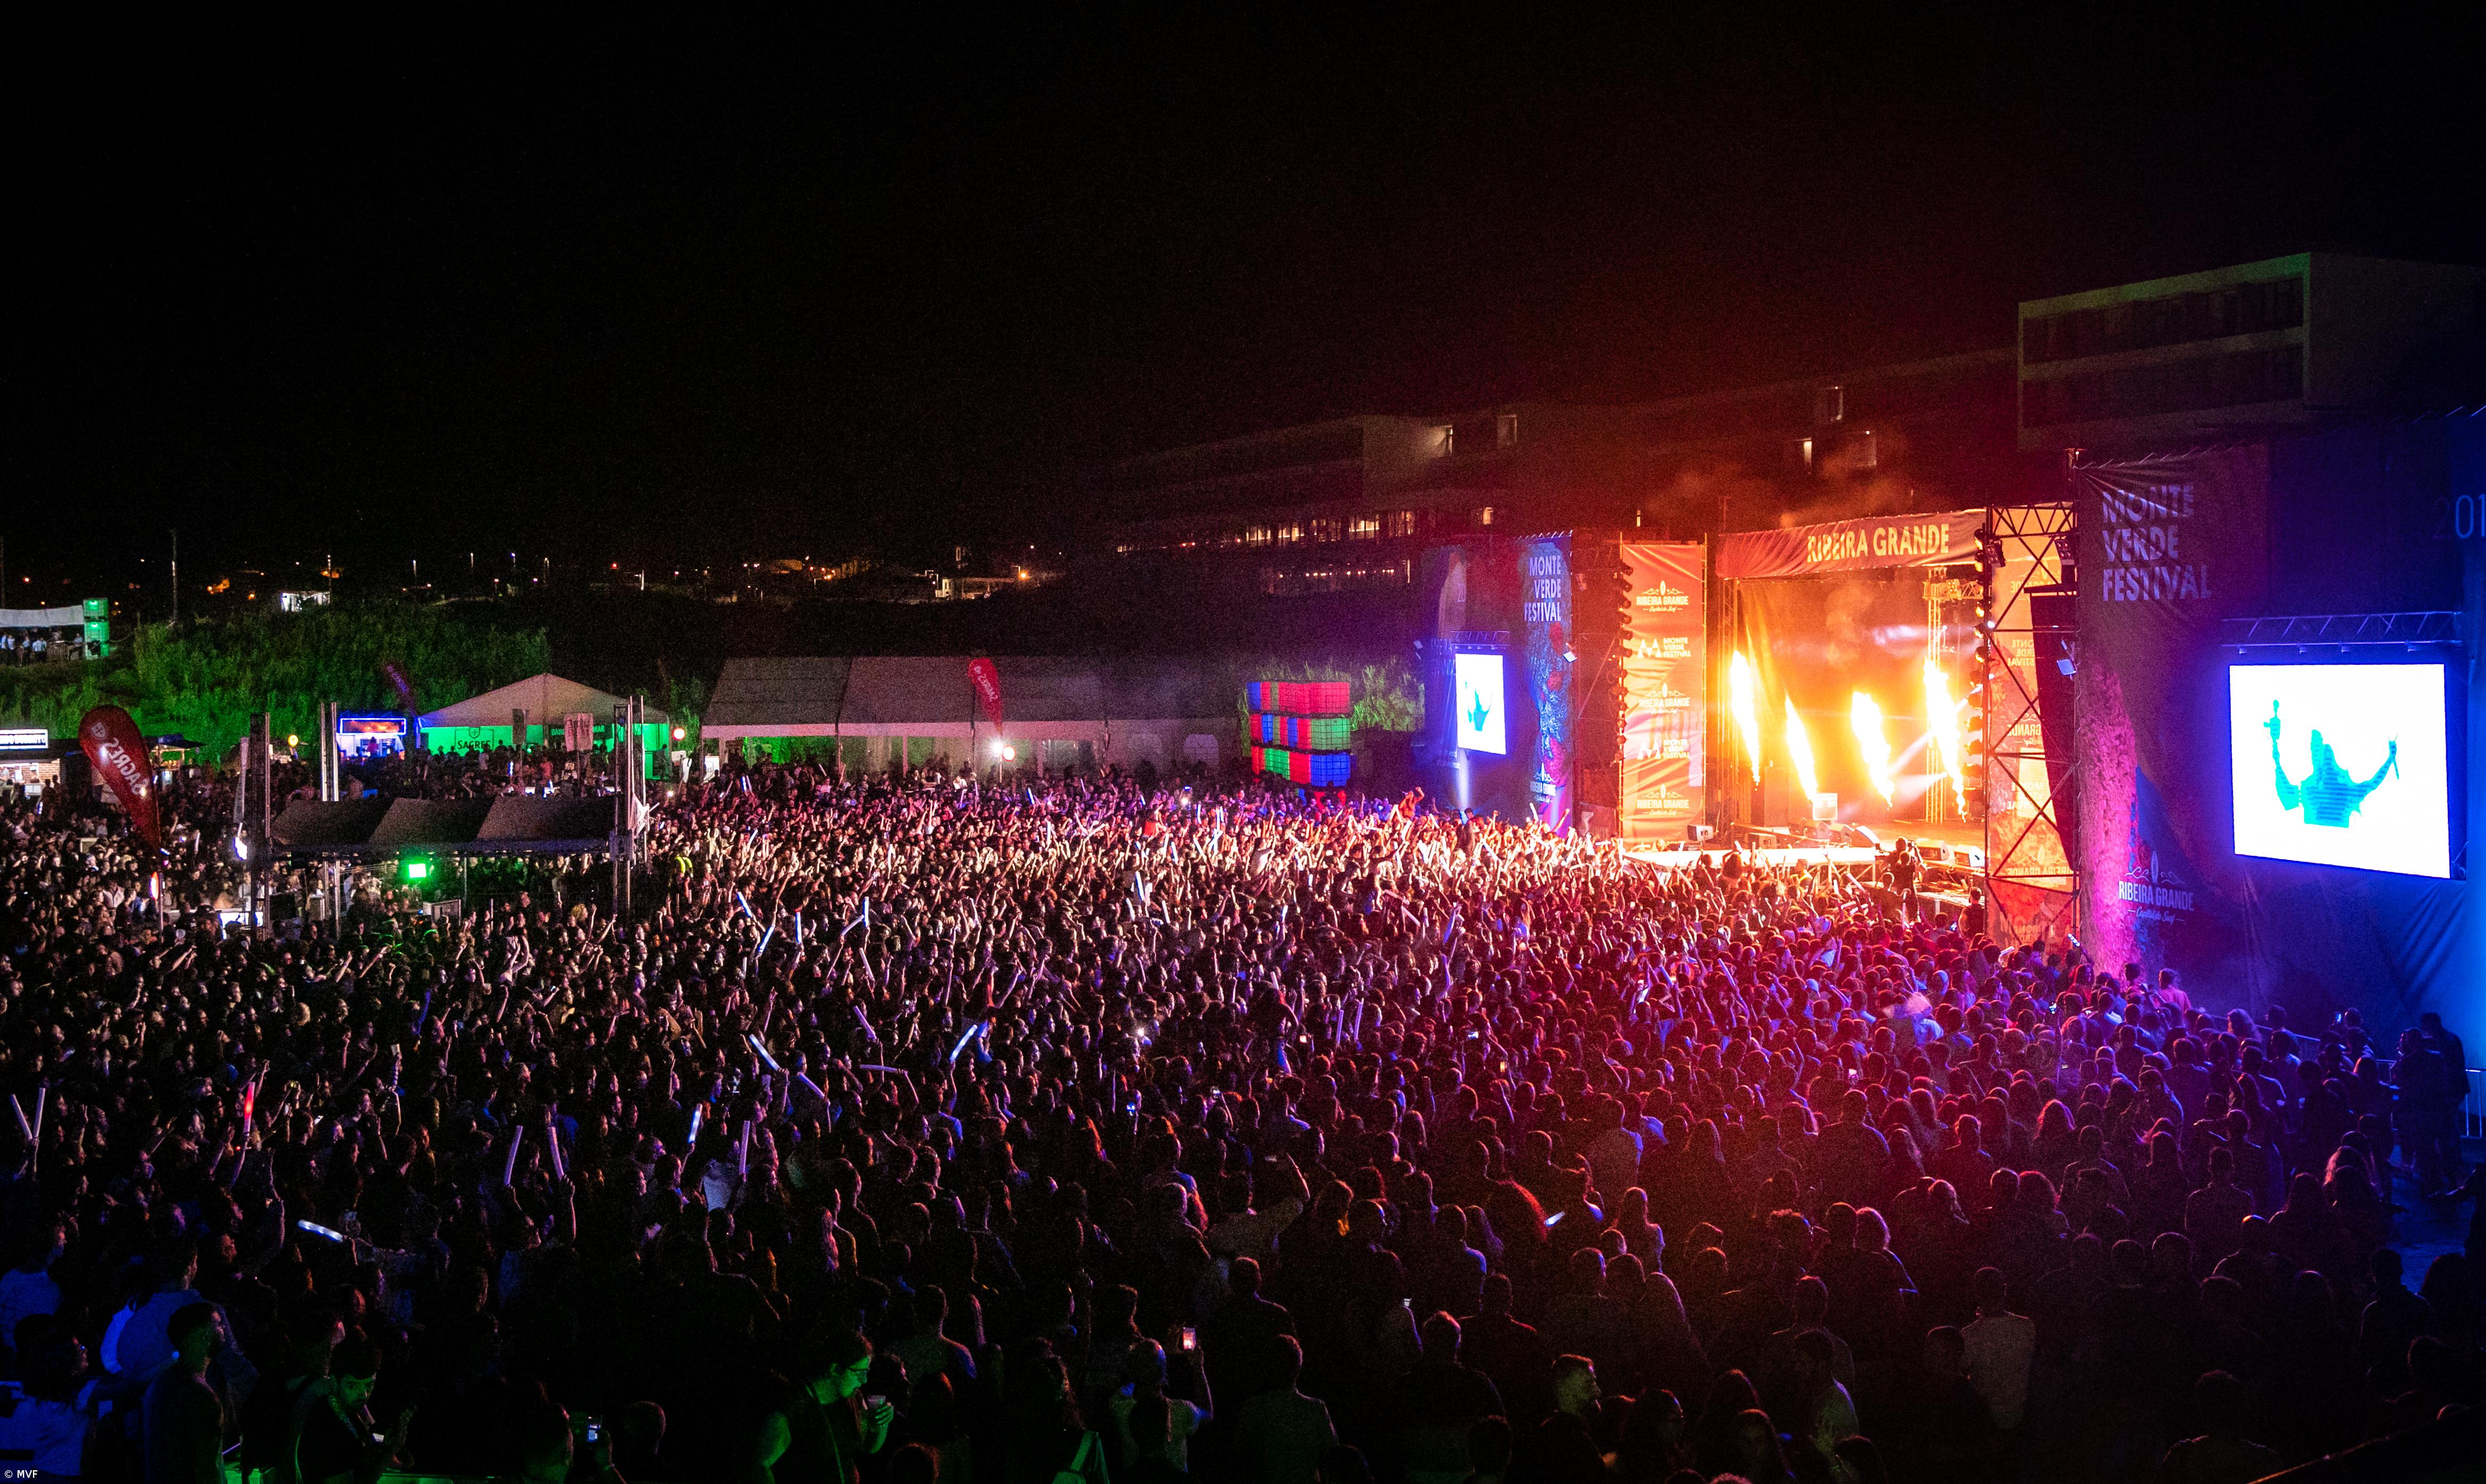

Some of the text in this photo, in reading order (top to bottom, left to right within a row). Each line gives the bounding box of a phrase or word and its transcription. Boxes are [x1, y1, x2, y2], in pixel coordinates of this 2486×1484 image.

[2103, 484, 2195, 518] MONTE
[1807, 524, 1949, 562] RIBEIRA GRANDE
[2102, 525, 2179, 562] VERDE
[1529, 556, 1561, 576] MONTE
[1534, 579, 1561, 598] VERDE
[2103, 564, 2212, 602] FESTIVAL
[1636, 596, 1689, 605] RIBEIRA GRANDE
[1524, 602, 1561, 621] FESTIVAL
[1665, 697, 1690, 706] GRANDE
[1637, 799, 1689, 808] RIBEIRA GRANDE
[2119, 880, 2195, 912] RIBEIRA GRANDE
